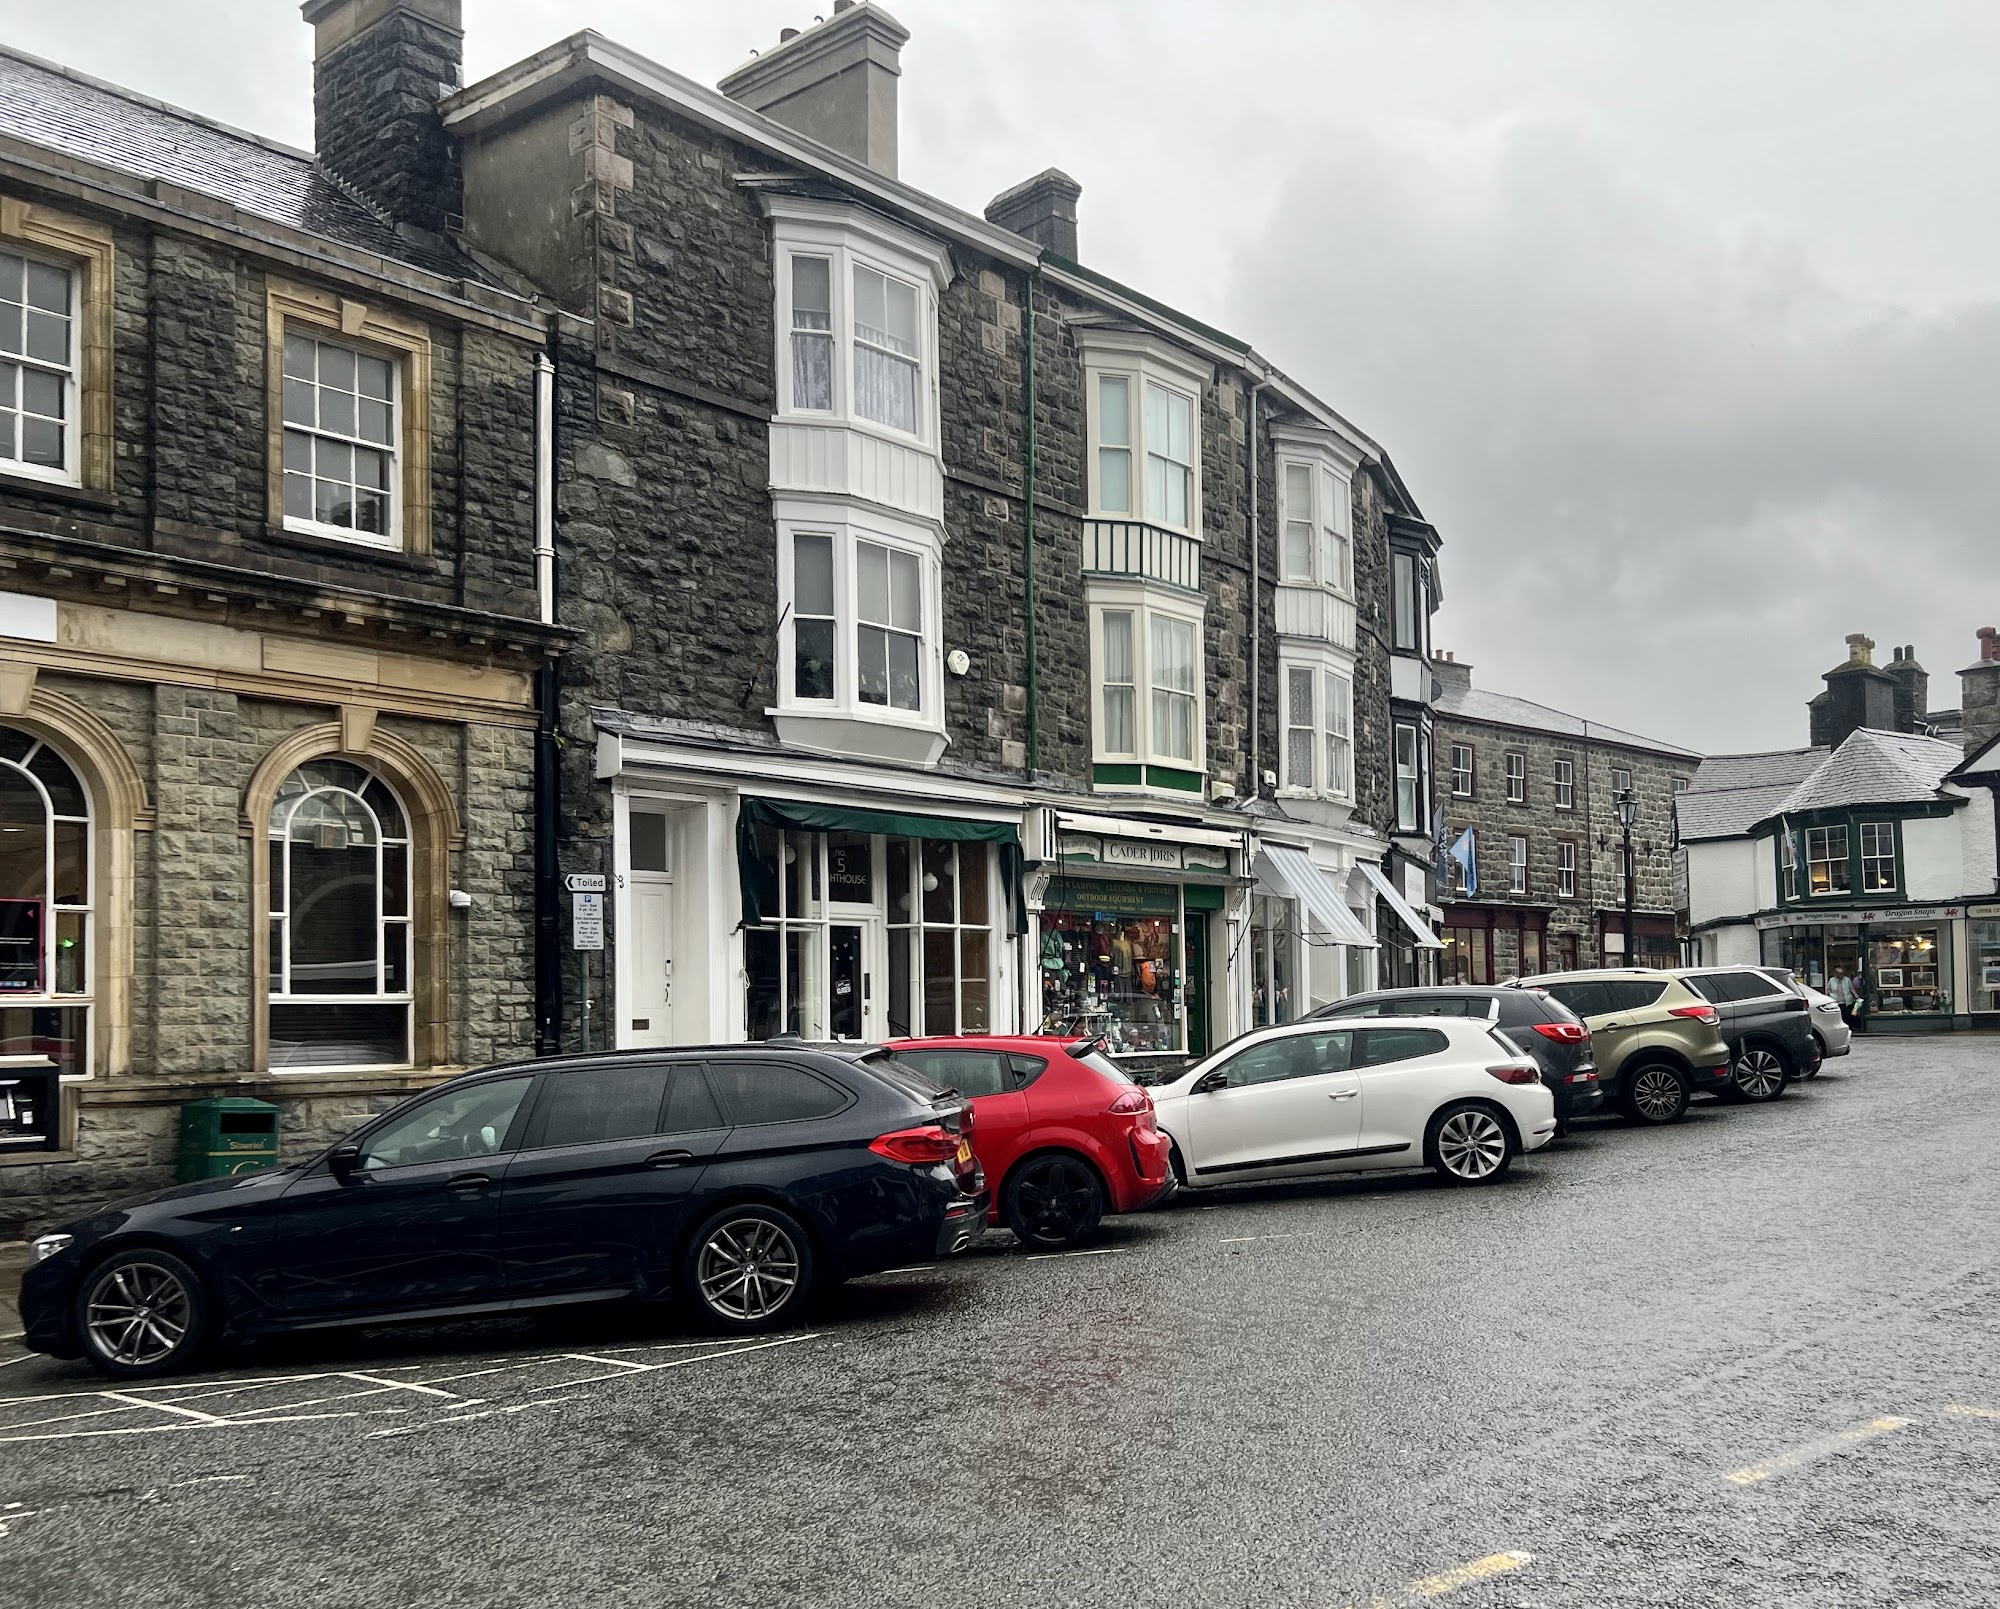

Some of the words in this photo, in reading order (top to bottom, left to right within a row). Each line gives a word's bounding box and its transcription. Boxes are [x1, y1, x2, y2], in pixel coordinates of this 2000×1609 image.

[1110, 843, 1147, 860] CADER
[1150, 847, 1176, 863] IDRIS
[837, 857, 846, 873] 5
[1077, 892, 1108, 902] OUTDOOR
[1109, 895, 1144, 904] EQUIPMENT
[1884, 910, 1912, 918] Dragon
[1913, 908, 1936, 916] Snaps
